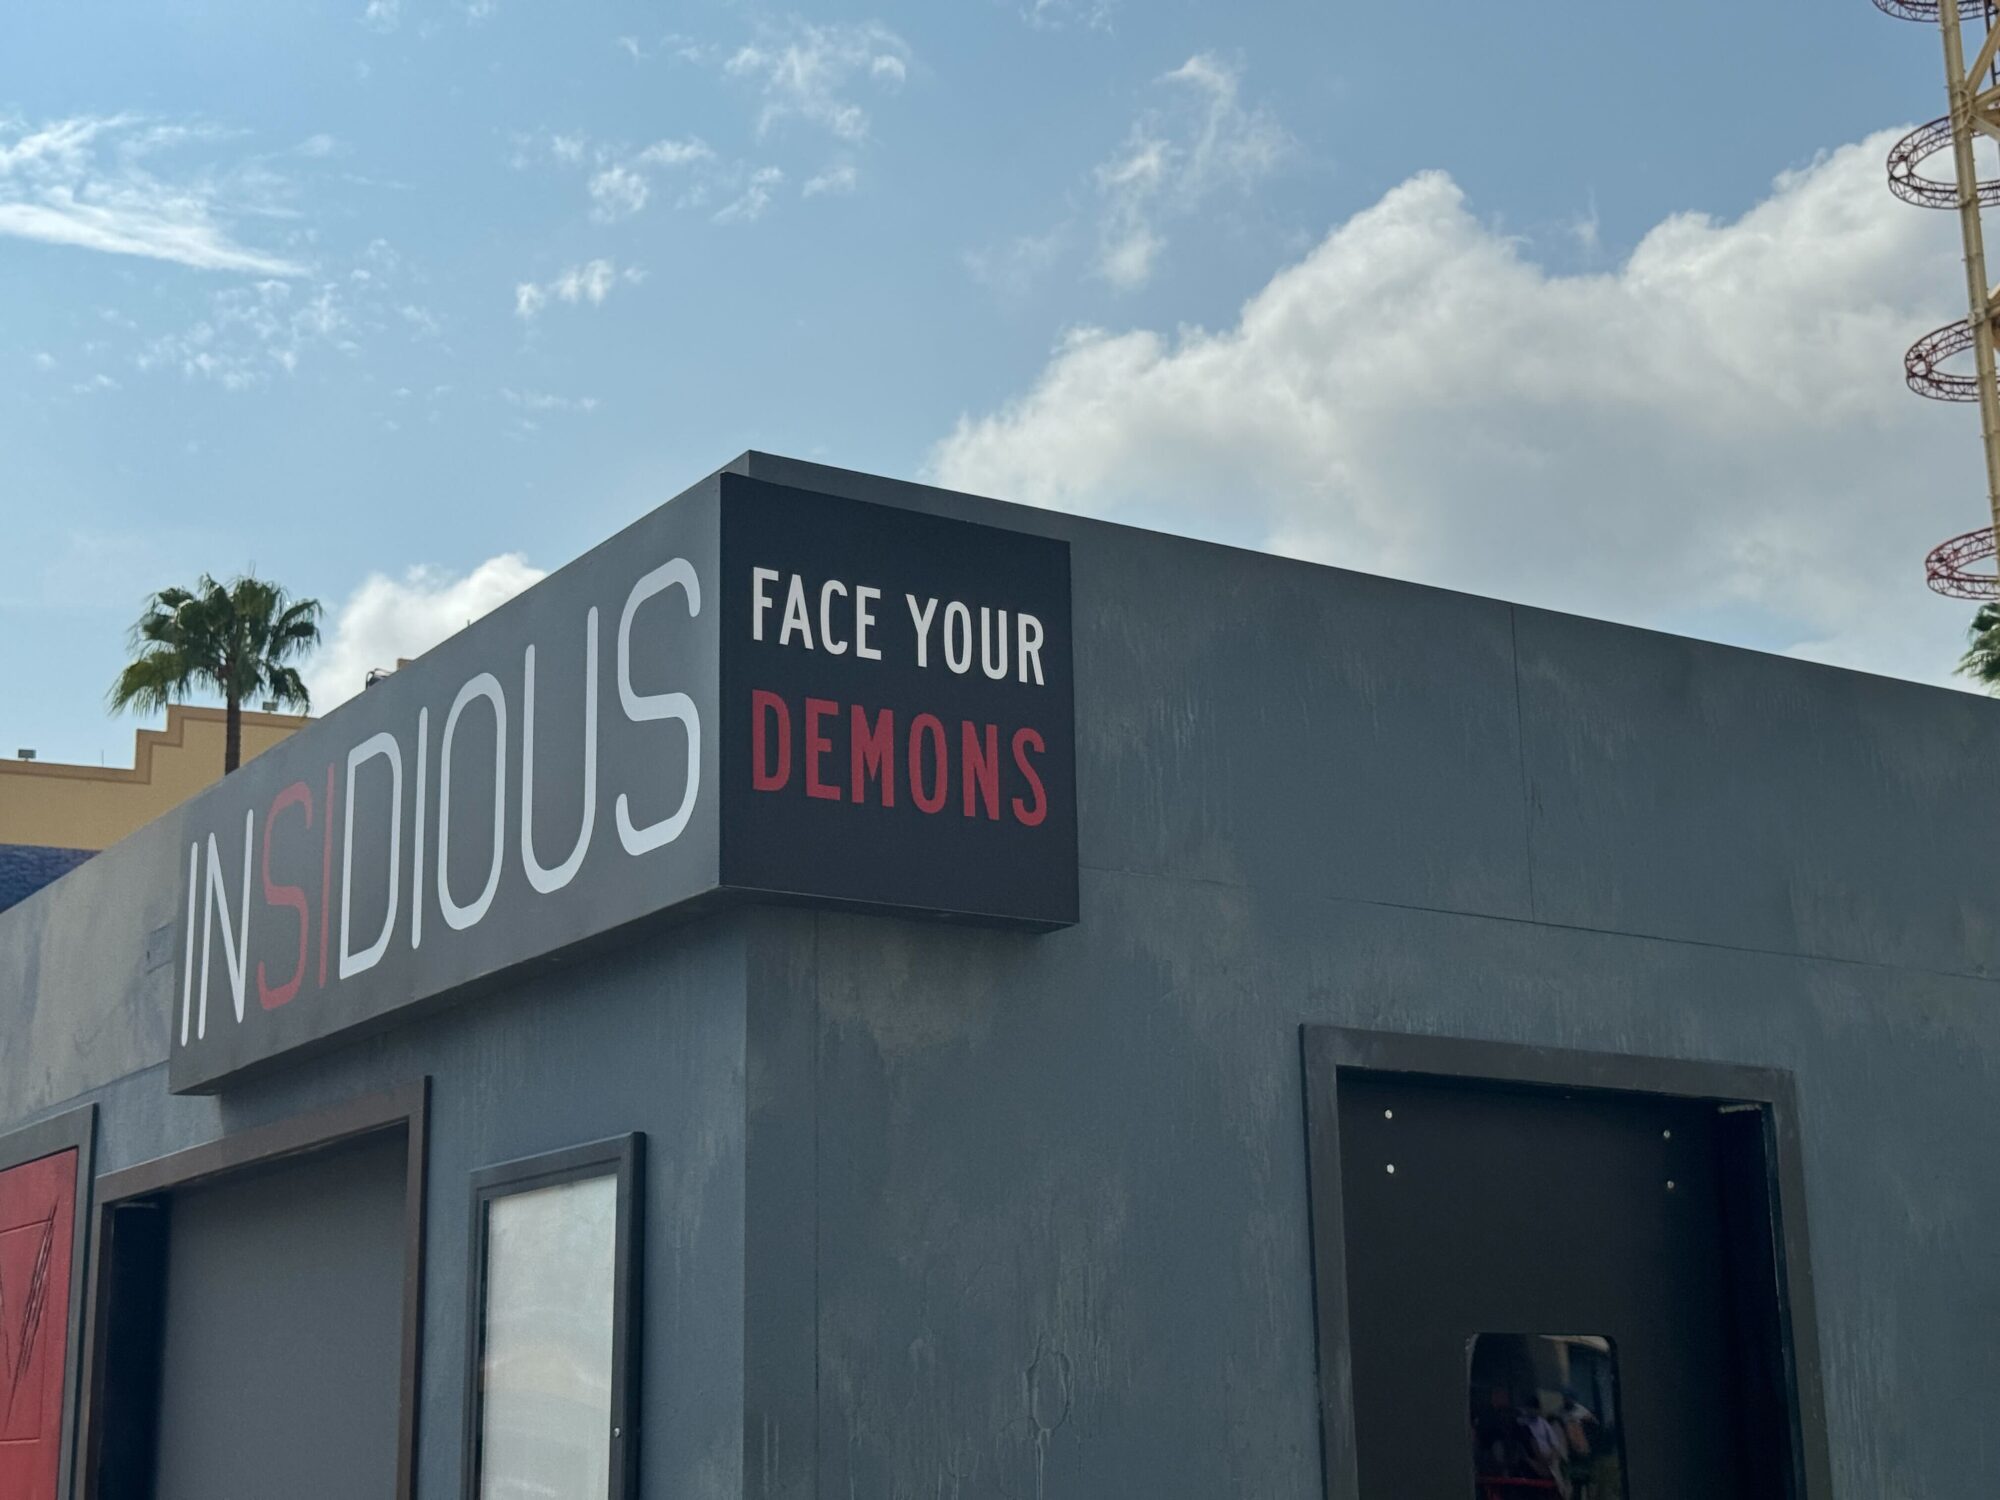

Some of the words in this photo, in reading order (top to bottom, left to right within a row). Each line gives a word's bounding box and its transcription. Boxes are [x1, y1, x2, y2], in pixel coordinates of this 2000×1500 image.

[752, 567, 882, 660] FACE
[905, 593, 1045, 685] YOUR
[181, 557, 701, 1047] INSIDIOUS
[752, 690, 1047, 827] DEMONS
